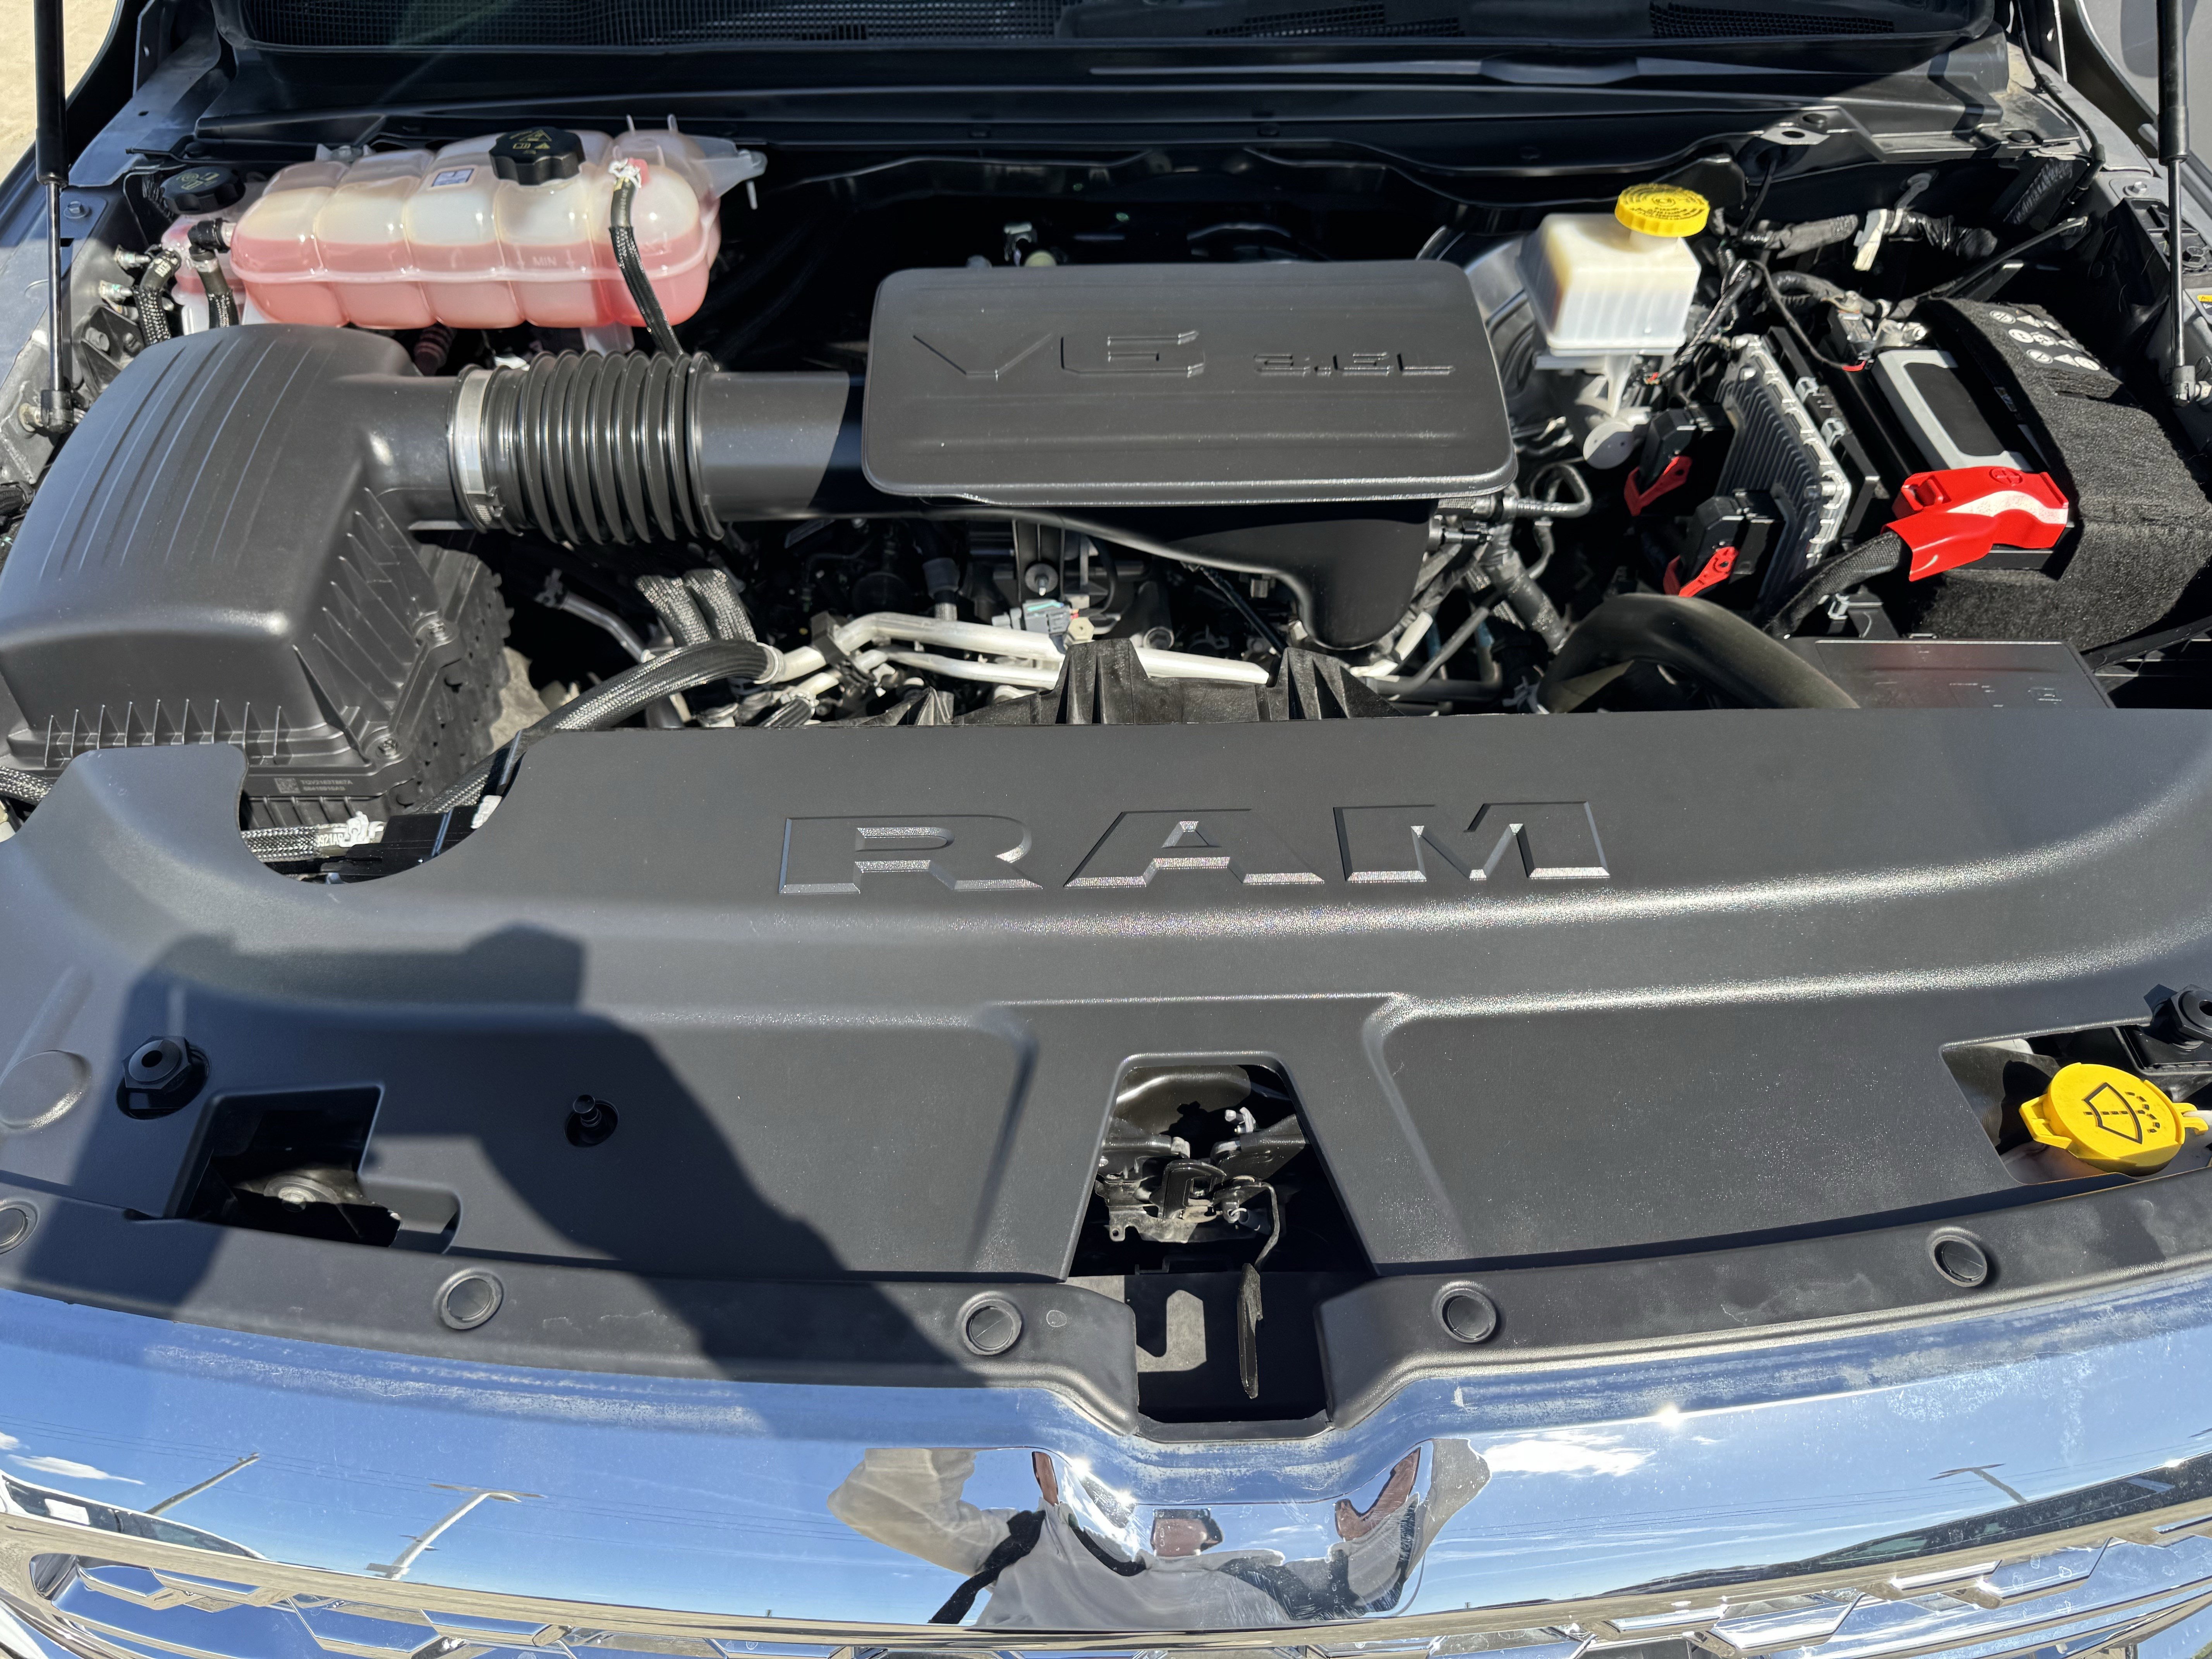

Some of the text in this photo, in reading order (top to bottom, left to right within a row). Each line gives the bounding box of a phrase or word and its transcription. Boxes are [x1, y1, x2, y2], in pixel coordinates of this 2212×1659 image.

[532, 256, 557, 266] MIN
[912, 330, 1456, 380] V6 3.6L
[778, 801, 1611, 895] RAM
